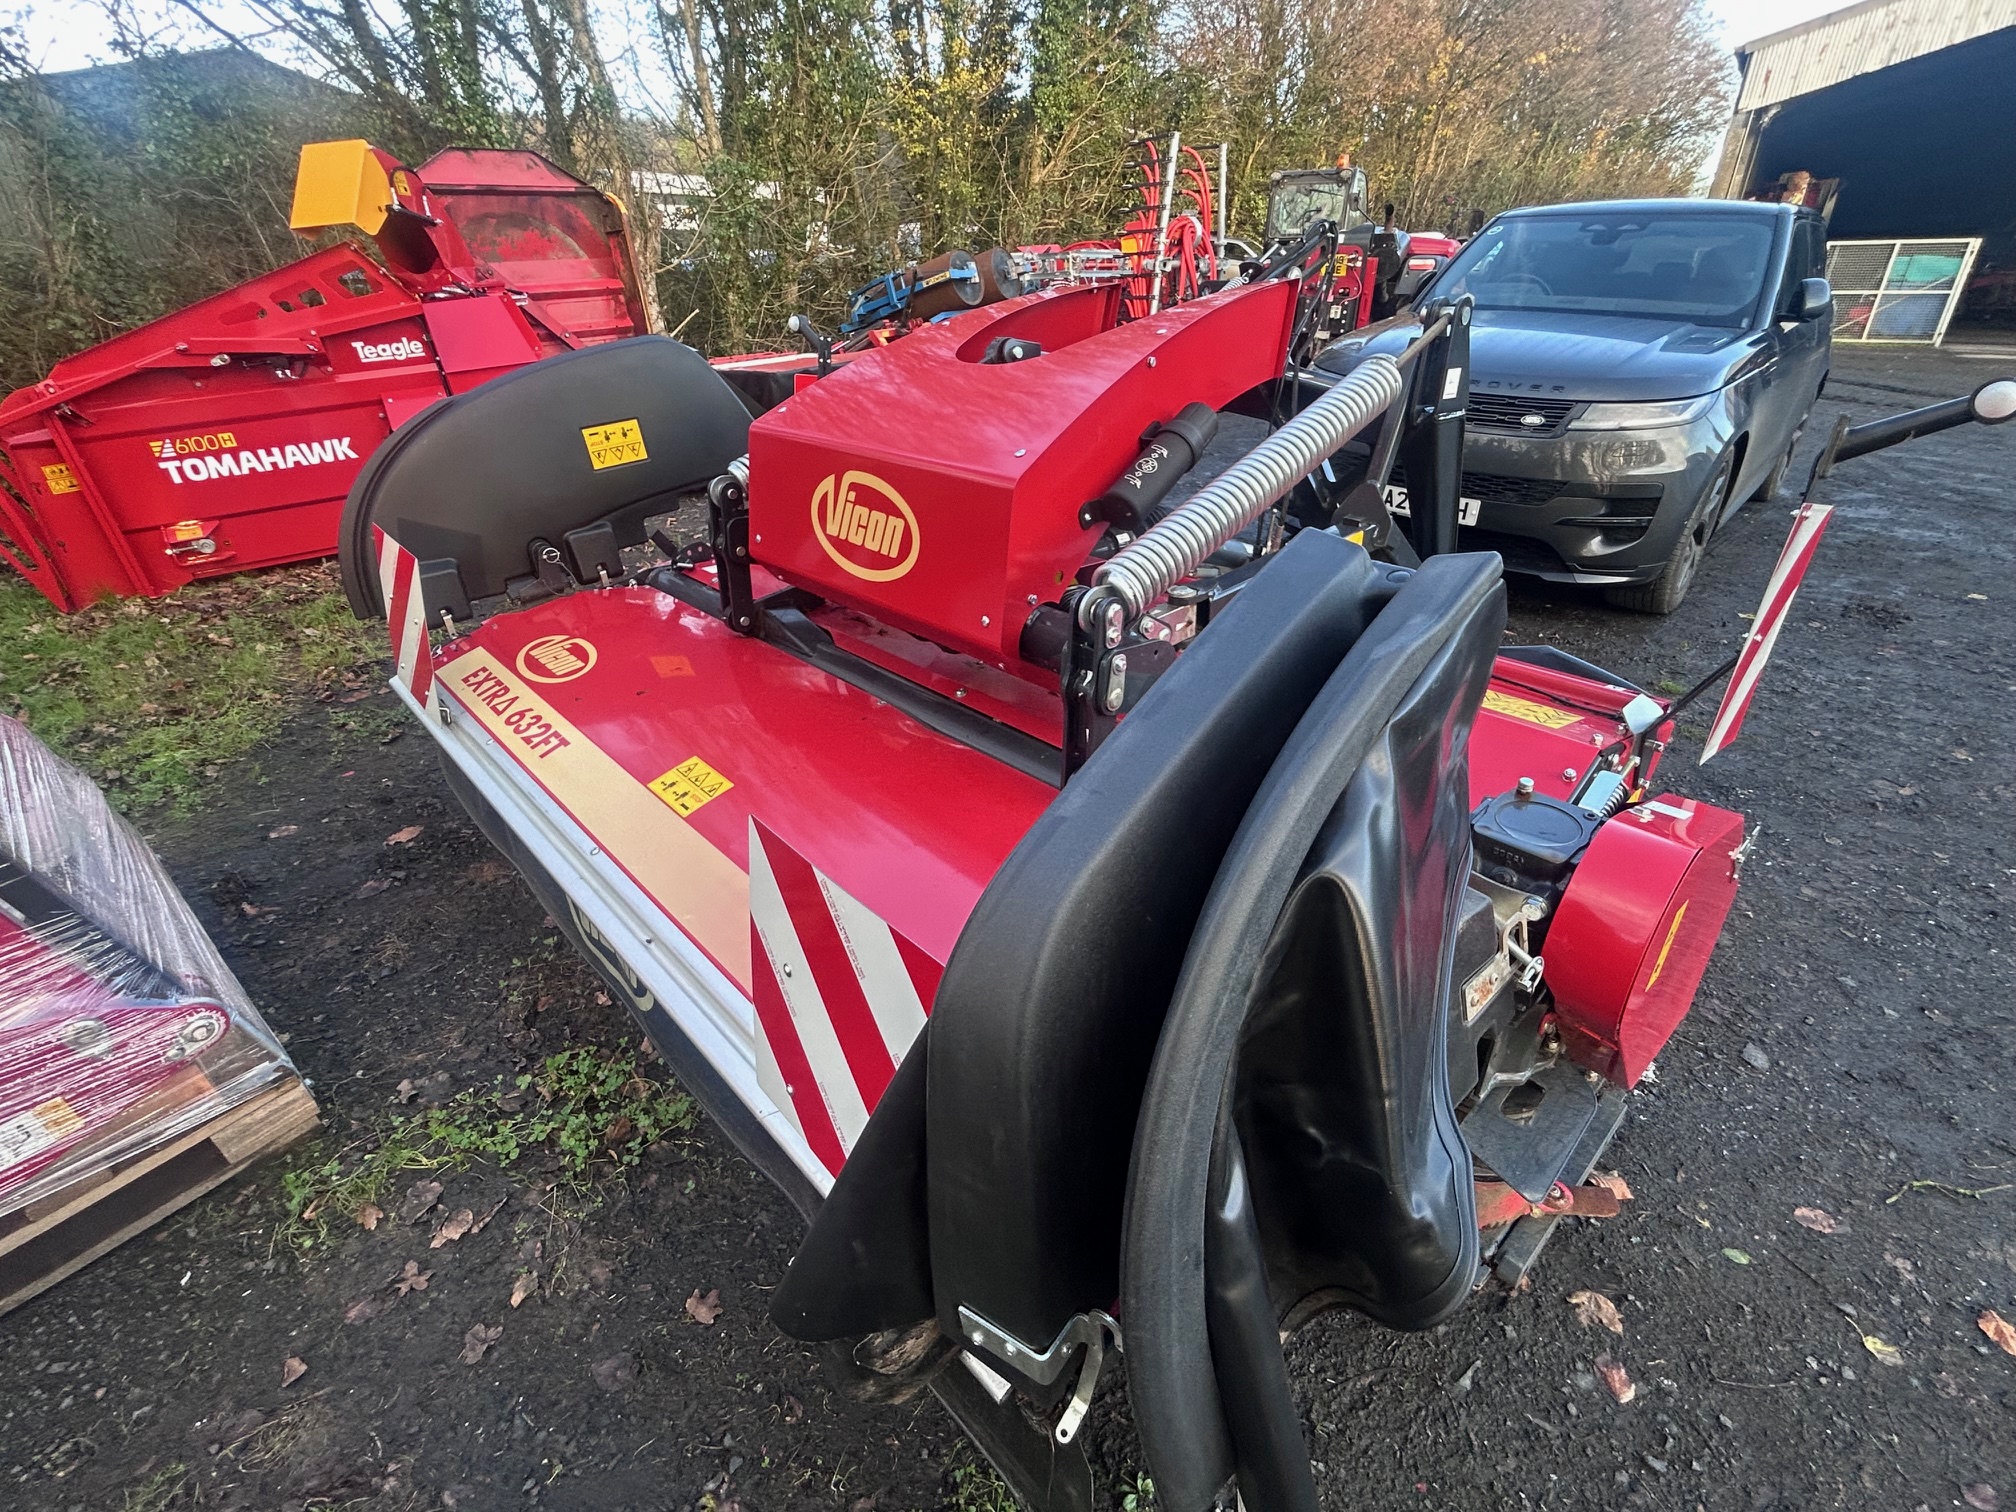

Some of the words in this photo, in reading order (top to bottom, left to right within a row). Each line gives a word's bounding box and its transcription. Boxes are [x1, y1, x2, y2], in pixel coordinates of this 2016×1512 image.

[351, 336, 424, 361] Teagle
[1470, 379, 1566, 394] ROVER
[158, 436, 359, 484] TOMAHAWK
[826, 470, 906, 559] Vicon
[528, 636, 586, 676] Vicon
[461, 665, 520, 717] EXTRA
[504, 707, 571, 759] 632FT
